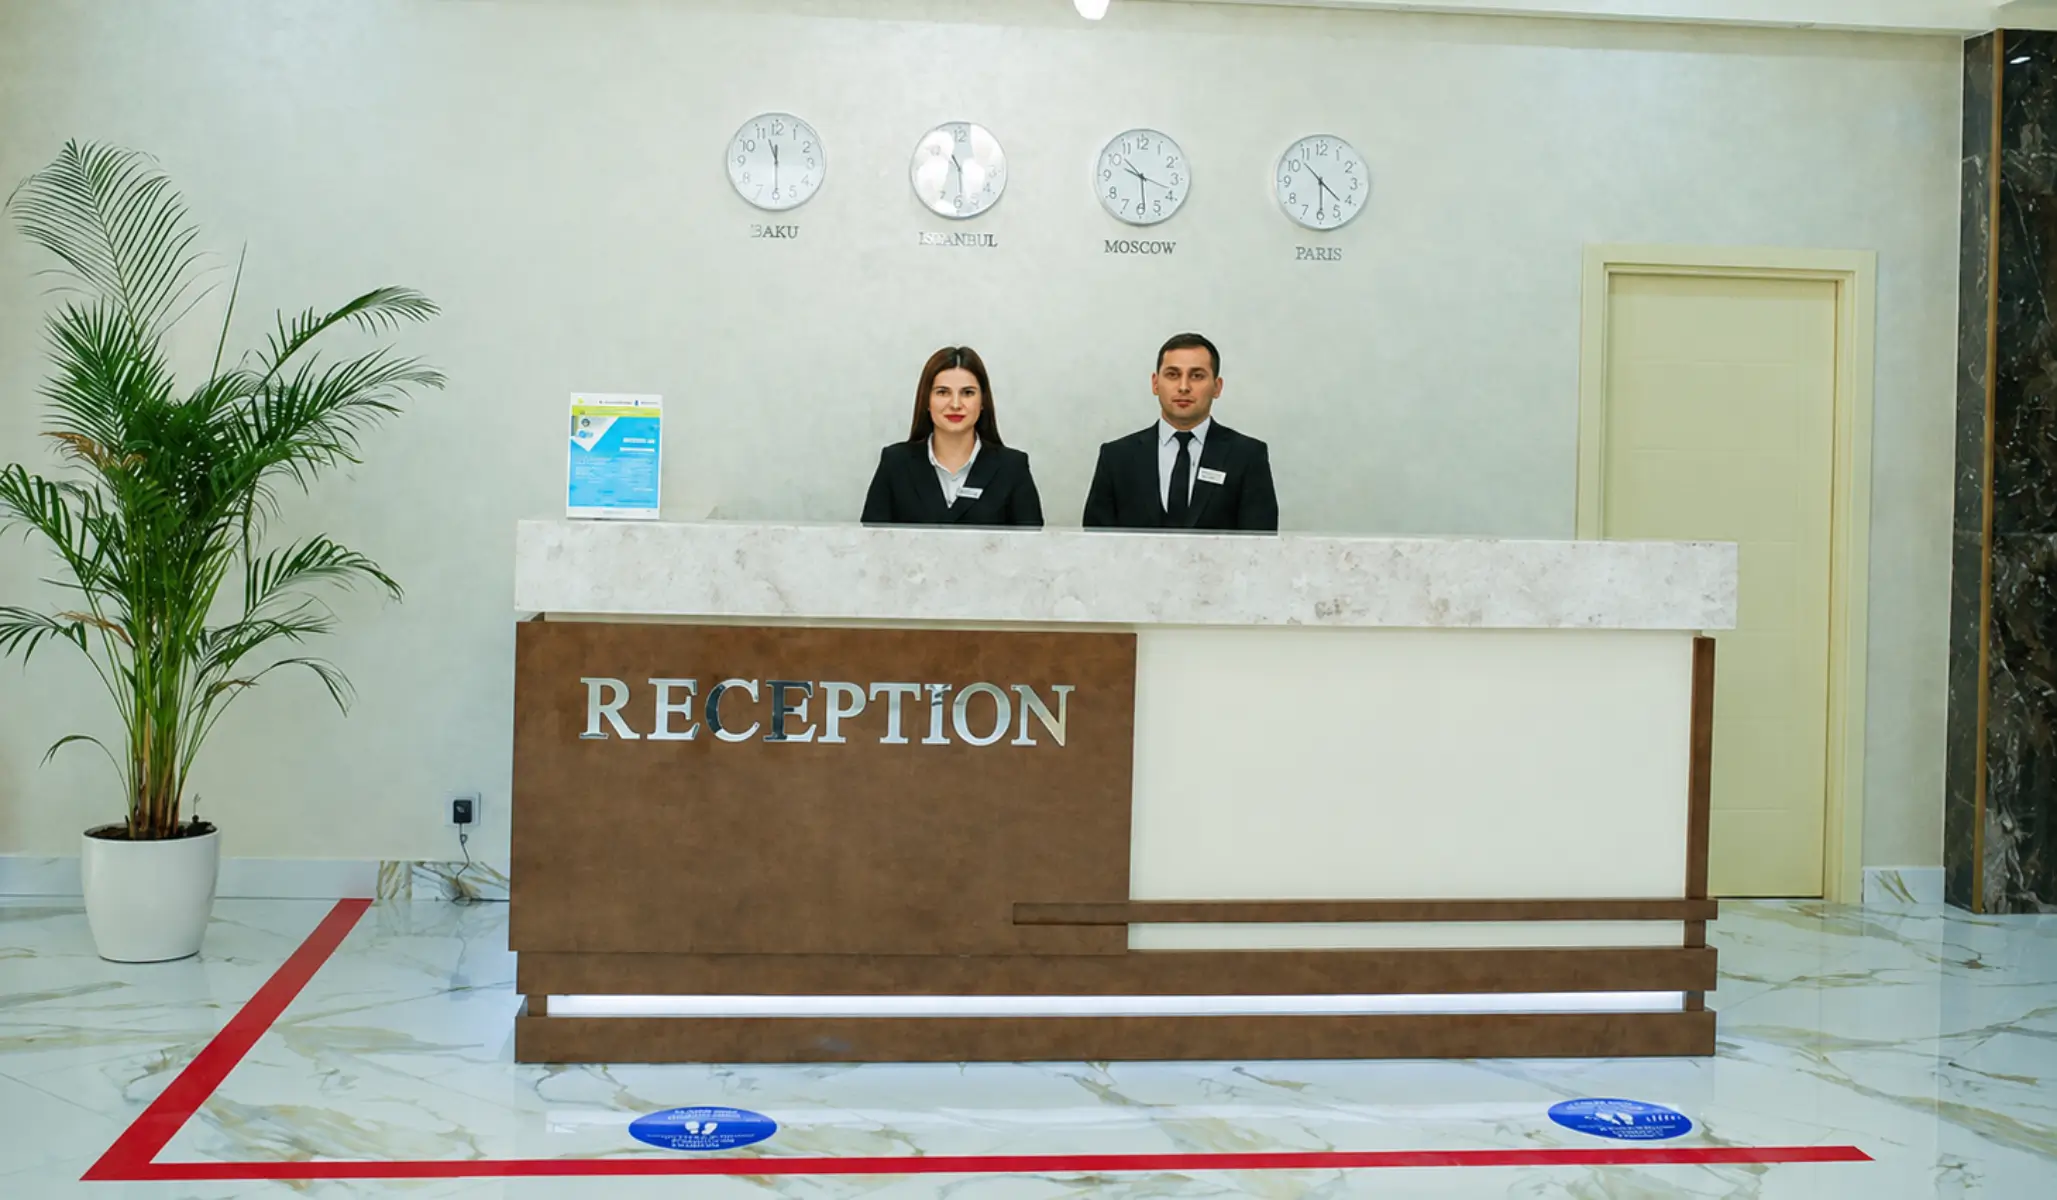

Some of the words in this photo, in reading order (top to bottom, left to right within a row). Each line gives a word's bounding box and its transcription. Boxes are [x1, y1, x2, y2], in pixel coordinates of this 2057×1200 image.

[757, 128, 766, 139] 11
[771, 122, 785, 136] 12
[954, 130, 967, 143] 12
[742, 139, 756, 153] 10
[1123, 142, 1131, 155] 11
[1137, 137, 1150, 151] 12
[1316, 143, 1329, 156] 12
[1301, 148, 1310, 161] 11
[1288, 159, 1301, 173] 10
[1104, 239, 1176, 255] MOSCOW
[1295, 246, 1343, 261] PARIS
[579, 677, 1076, 747] RECEPTION
